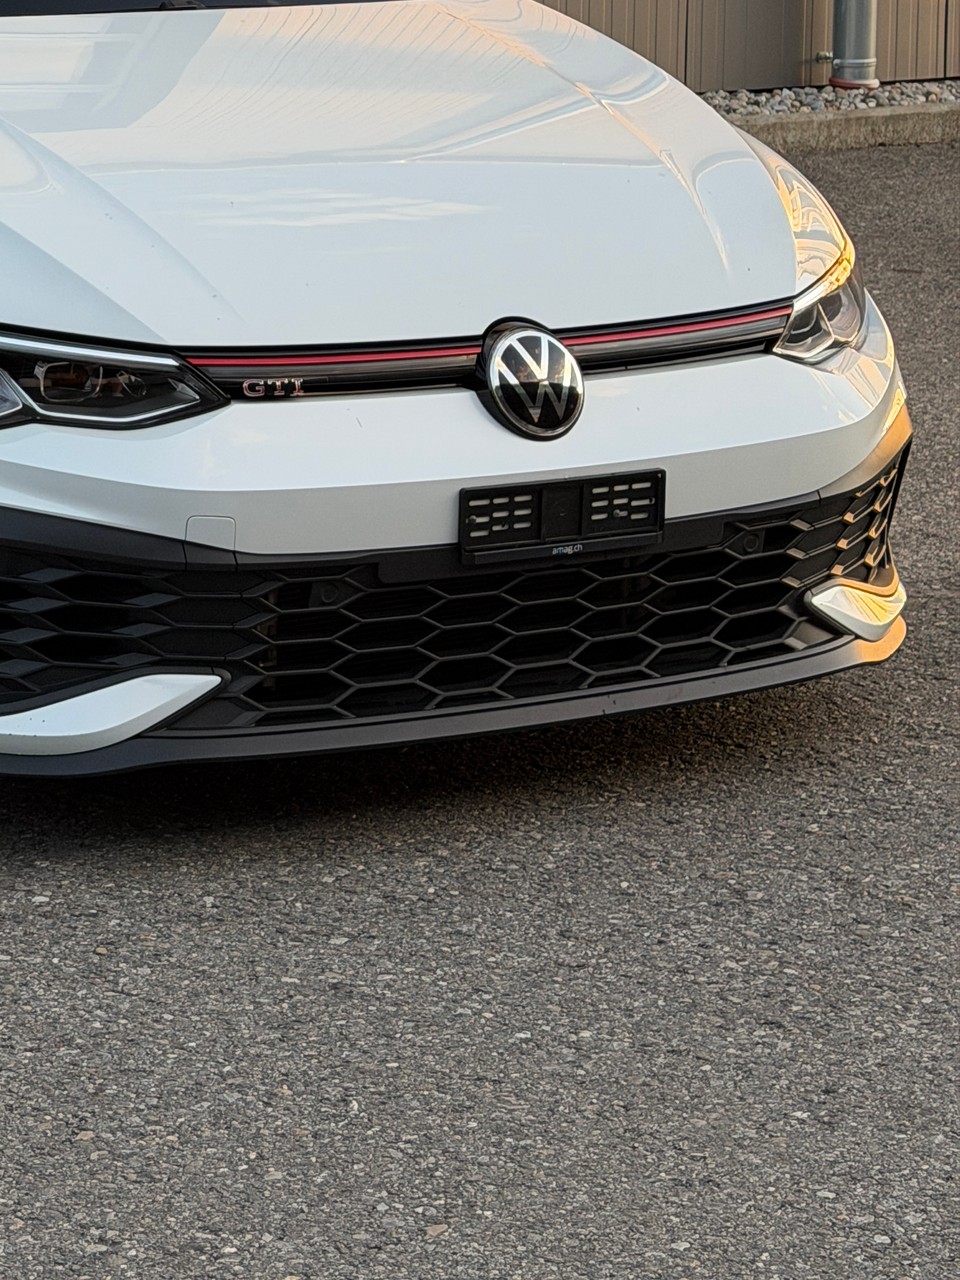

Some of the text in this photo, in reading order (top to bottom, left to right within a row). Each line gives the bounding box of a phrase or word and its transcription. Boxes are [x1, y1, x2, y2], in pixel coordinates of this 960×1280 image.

[243, 378, 304, 397] GTI
[491, 330, 583, 435] VW
[552, 544, 583, 555] amag.ch
